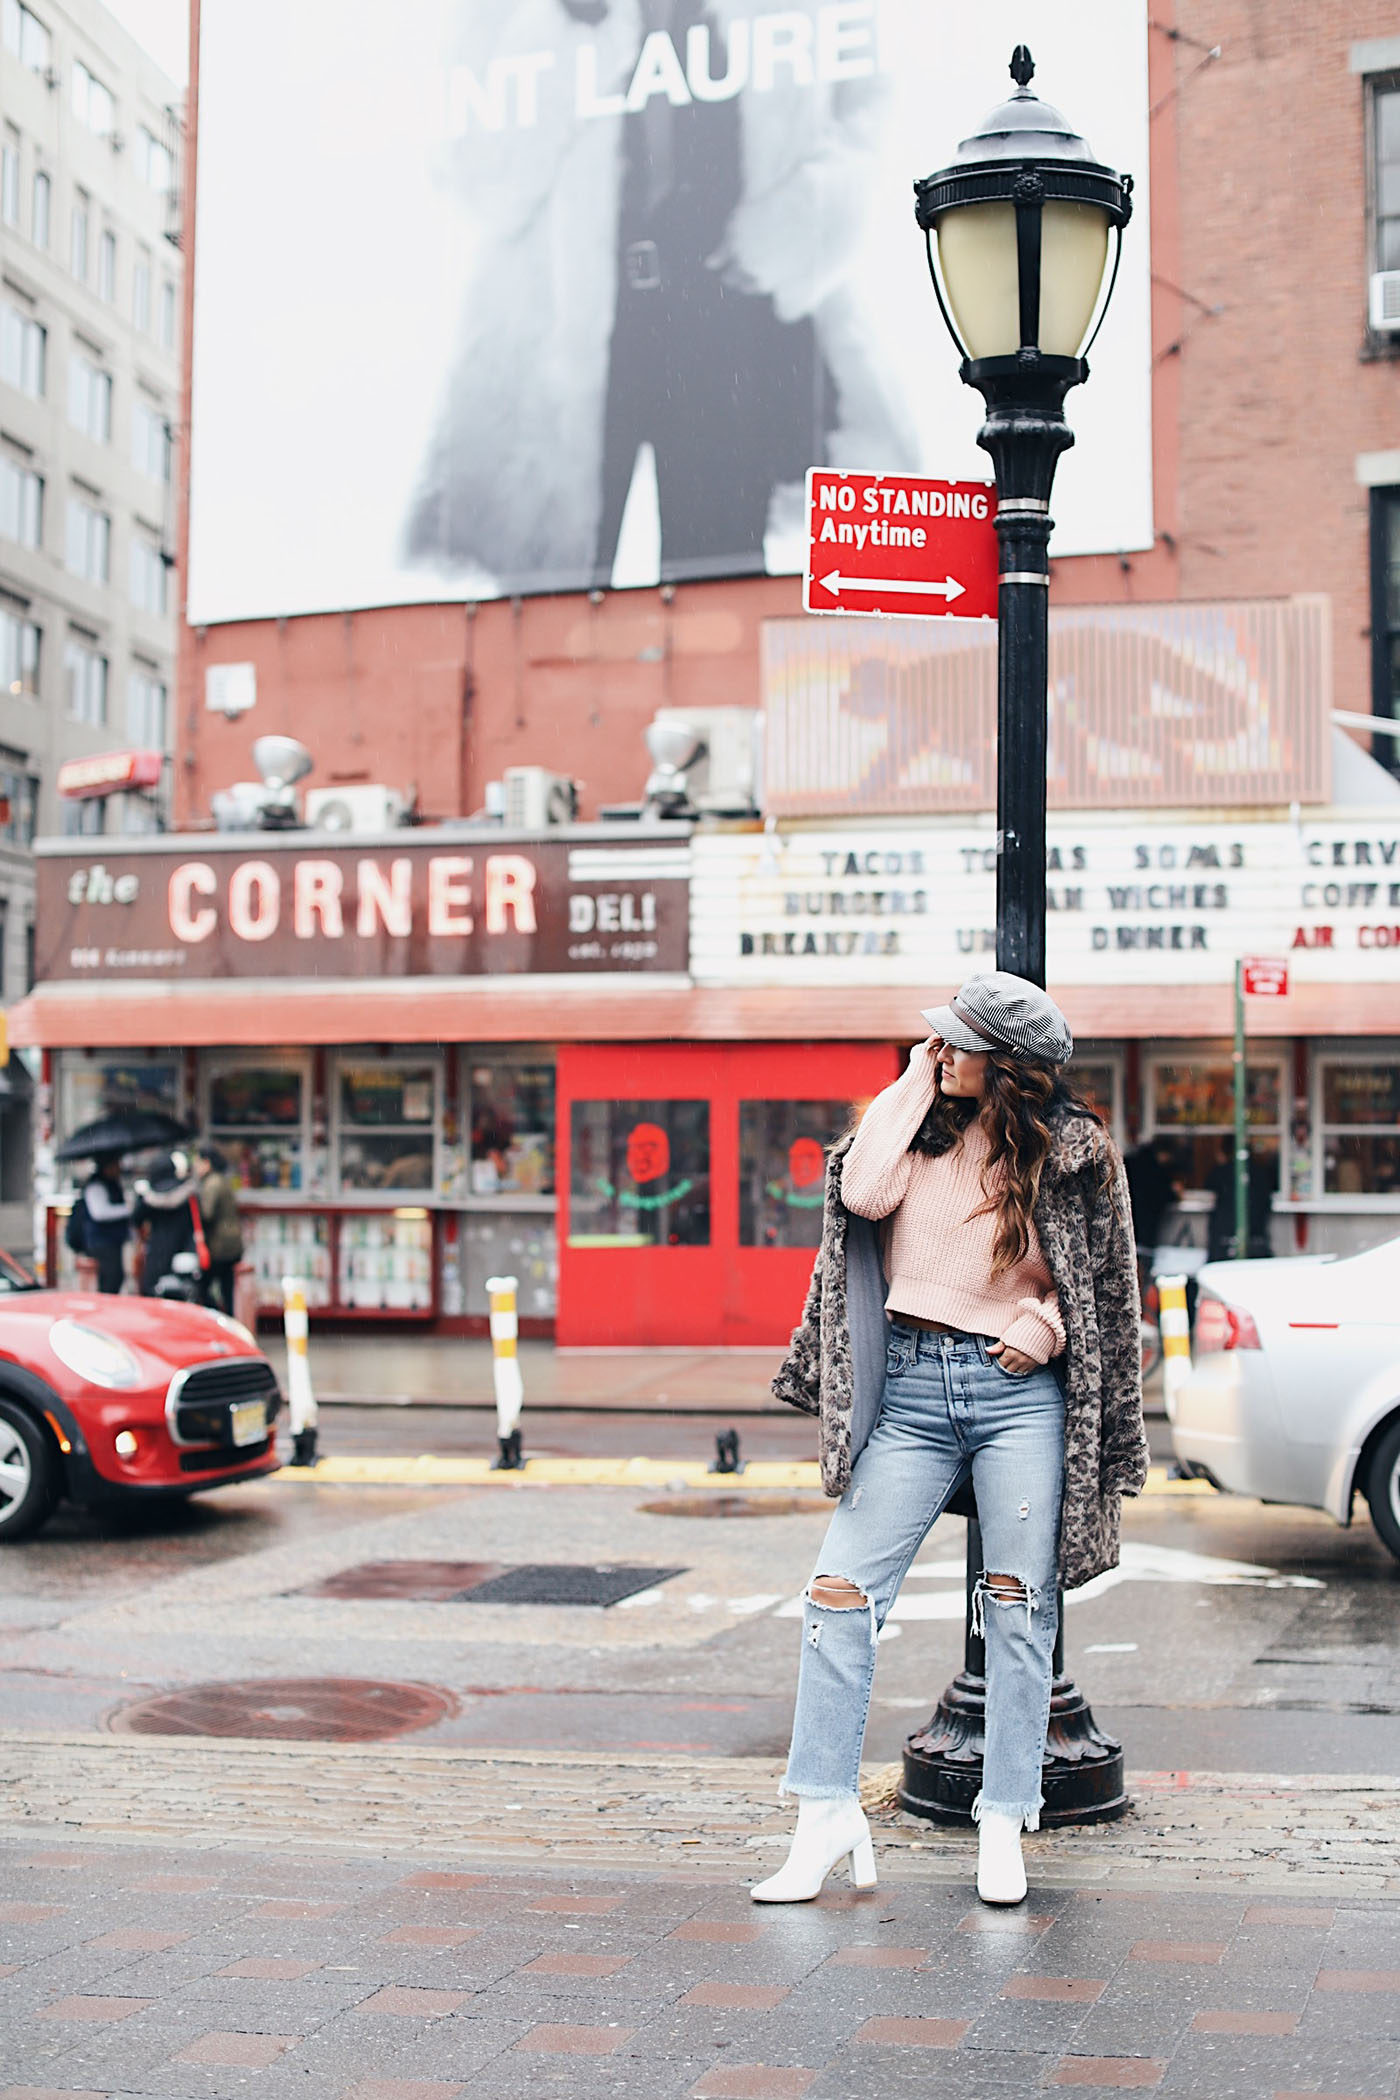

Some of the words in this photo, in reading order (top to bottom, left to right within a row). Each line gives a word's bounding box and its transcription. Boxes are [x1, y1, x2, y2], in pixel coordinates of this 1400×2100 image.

[819, 484, 856, 512] NO
[862, 487, 989, 520] STANDING
[819, 517, 928, 551] Anytime
[820, 850, 925, 876] TACOS
[960, 845, 1086, 872] TOAS
[1308, 840, 1398, 866] CERV
[68, 864, 140, 905] the
[168, 854, 538, 942] CORNER
[783, 889, 928, 916] BURGERS
[1046, 887, 1083, 911] AN
[568, 892, 657, 934] DELI
[1291, 926, 1334, 949] AIR
